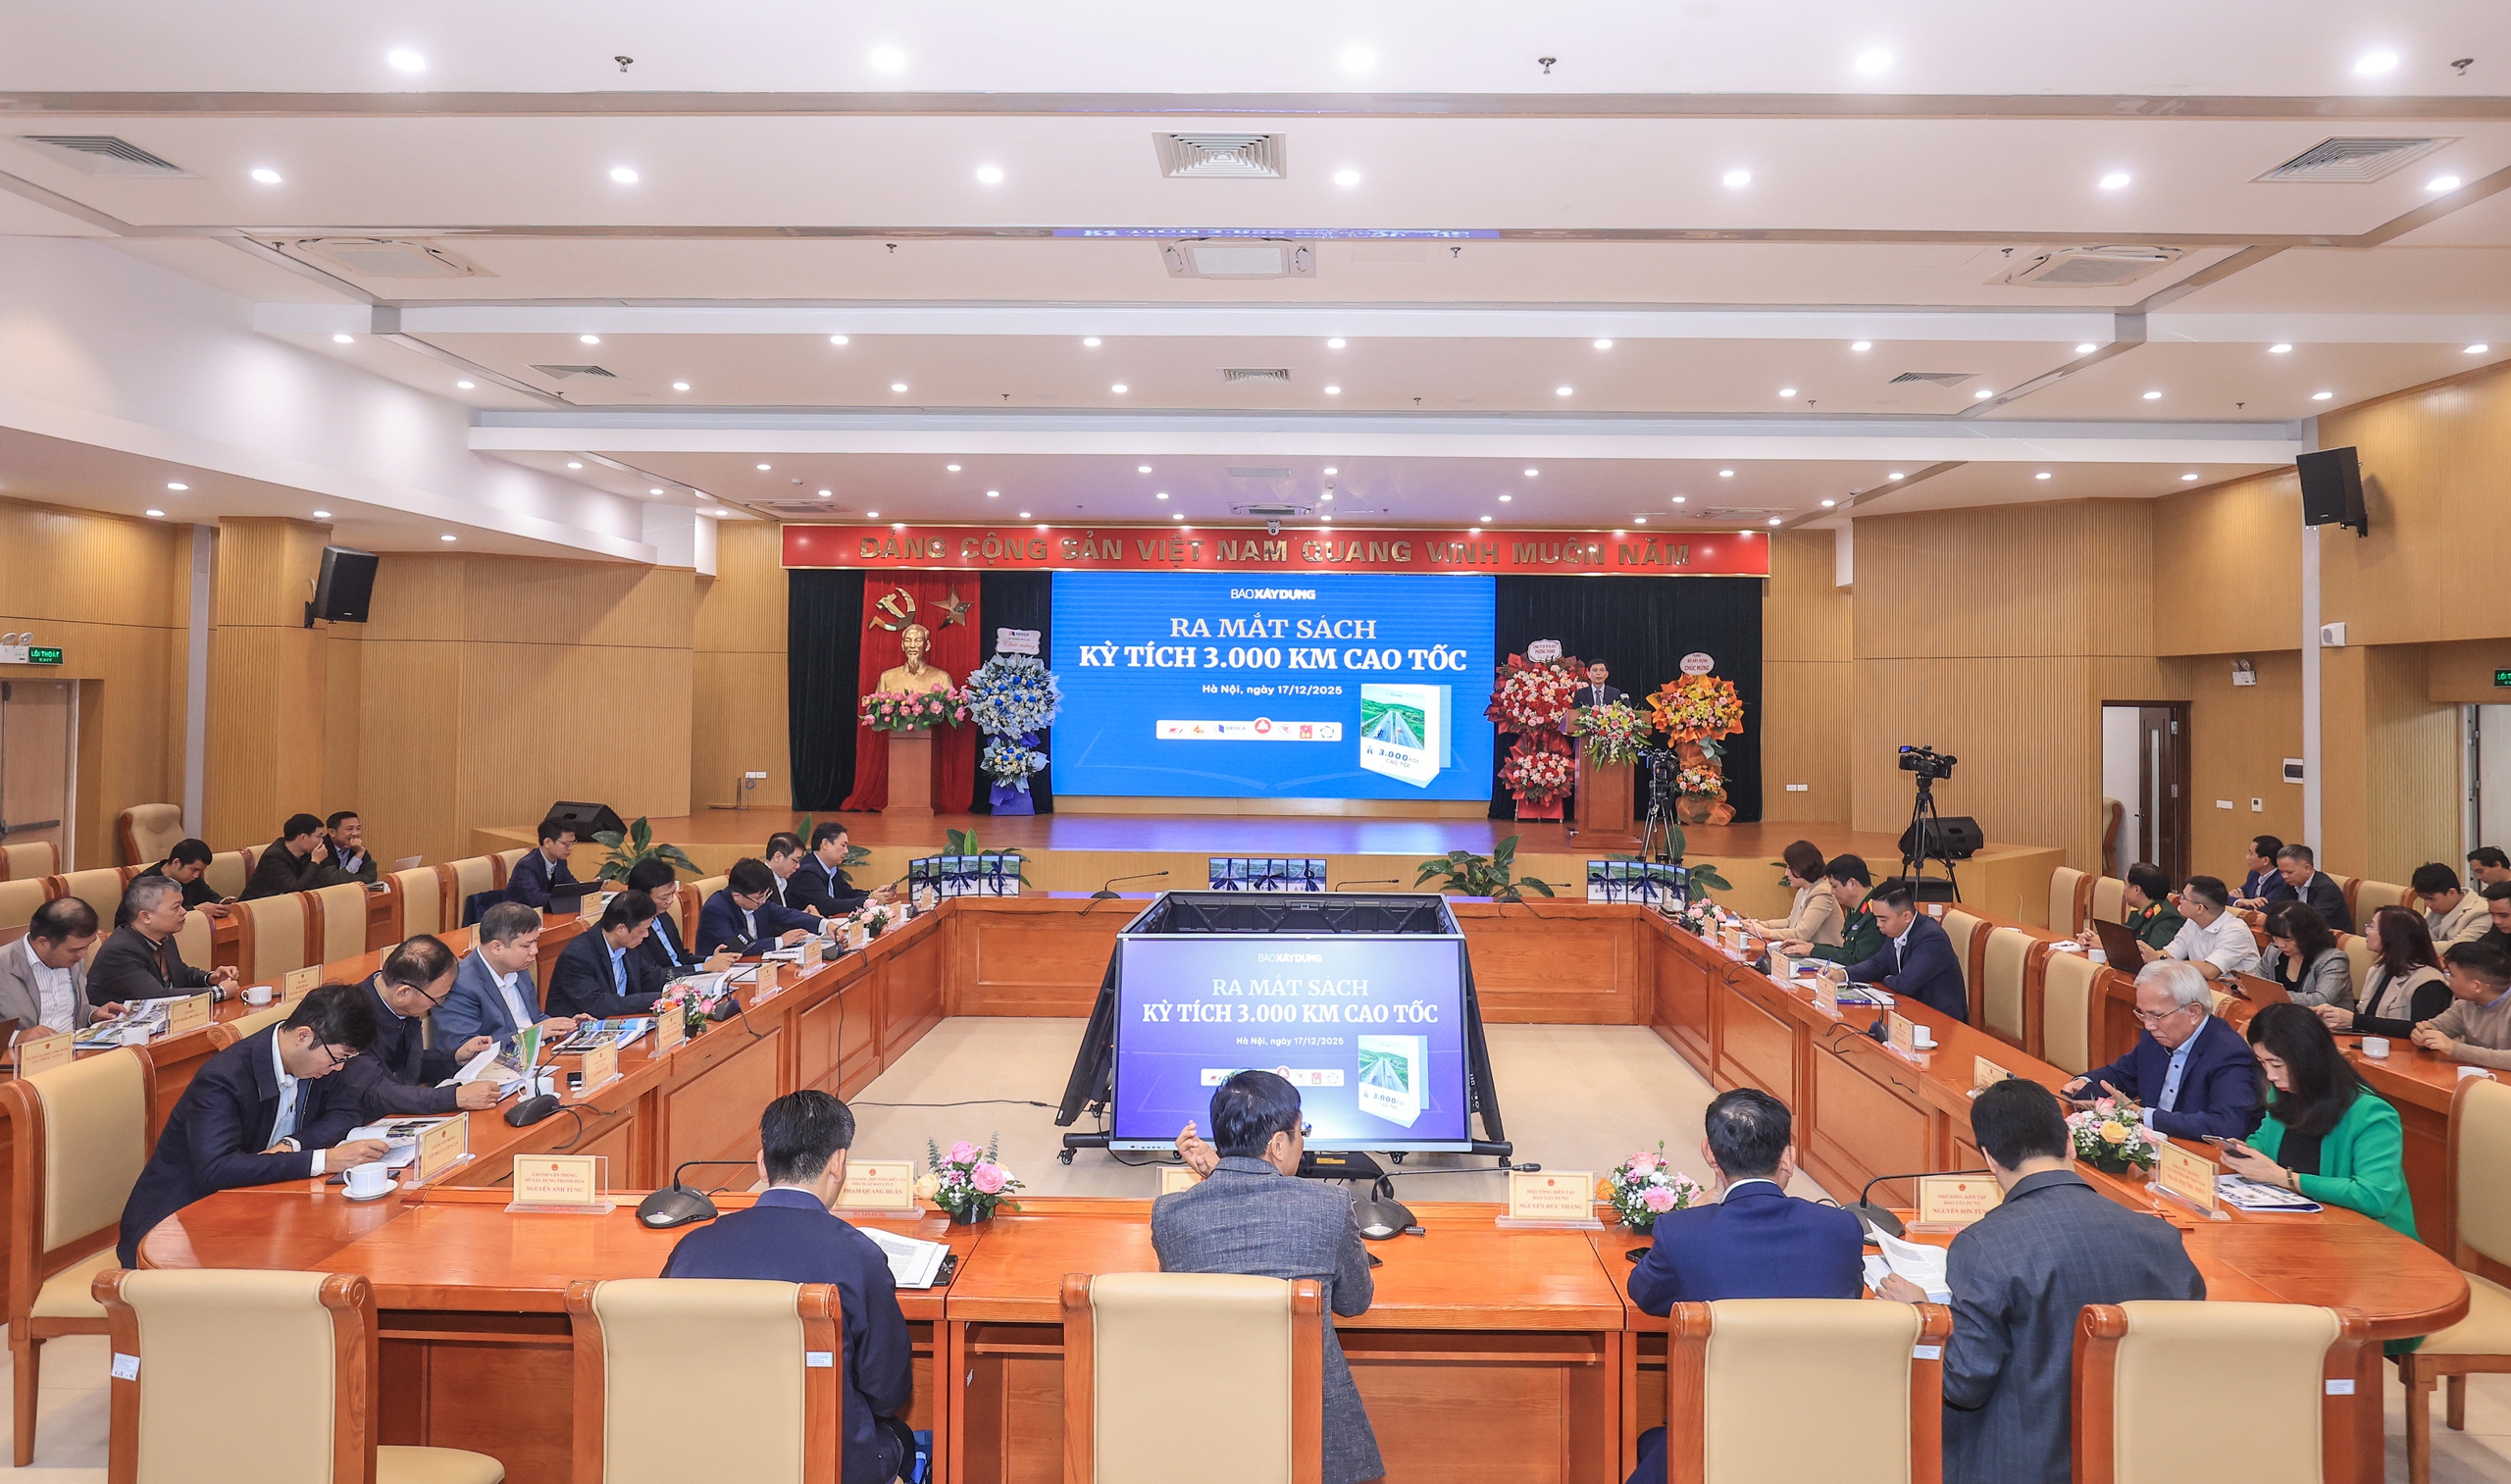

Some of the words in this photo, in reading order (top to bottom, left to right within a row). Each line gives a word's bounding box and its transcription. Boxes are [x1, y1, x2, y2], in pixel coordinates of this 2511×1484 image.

[860, 528, 948, 559] ĐẢNG
[960, 533, 1048, 565] CỘNG
[1060, 531, 1124, 561] SẢN
[1136, 534, 1205, 567] VIỆT
[1217, 537, 1288, 562] NAM
[1302, 539, 1412, 564] QUANG
[1425, 541, 1500, 564] VINH
[1512, 537, 1606, 565] MUÔN
[1618, 537, 1691, 566] NĂM
[1170, 618, 1209, 638] RA
[1218, 612, 1289, 639] MẮT
[1297, 615, 1377, 640] SÁCH
[1079, 640, 1115, 668] KỲ
[1124, 642, 1198, 669] TÍCH
[1203, 646, 1282, 669] 3.000
[1289, 647, 1339, 670] KM
[1344, 648, 1402, 671] CAO
[1408, 643, 1467, 671] TỐC
[1203, 684, 1217, 694] Hà
[1220, 685, 1244, 695] Nội,
[1247, 686, 1275, 696] ngày
[1277, 685, 1343, 695] 17/12/2025
[1379, 749, 1409, 761] 3.000
[1212, 979, 1243, 997] RA
[1249, 974, 1302, 997] MẮT
[1311, 975, 1368, 997] SÁCH
[1142, 999, 1173, 1022] KỲ
[1177, 1000, 1231, 1023] TÍCH
[1238, 1003, 1297, 1023] 3.000
[1303, 1004, 1340, 1023] KM
[1344, 1003, 1389, 1023] CAO
[1393, 999, 1439, 1023] TỐC
[1236, 1037, 1249, 1046] Hà
[1250, 1037, 1268, 1047] Nội,
[1270, 1038, 1293, 1047] ngày
[1294, 1037, 1344, 1046] 17/12/2025
[1373, 1093, 1397, 1104] 3.000
